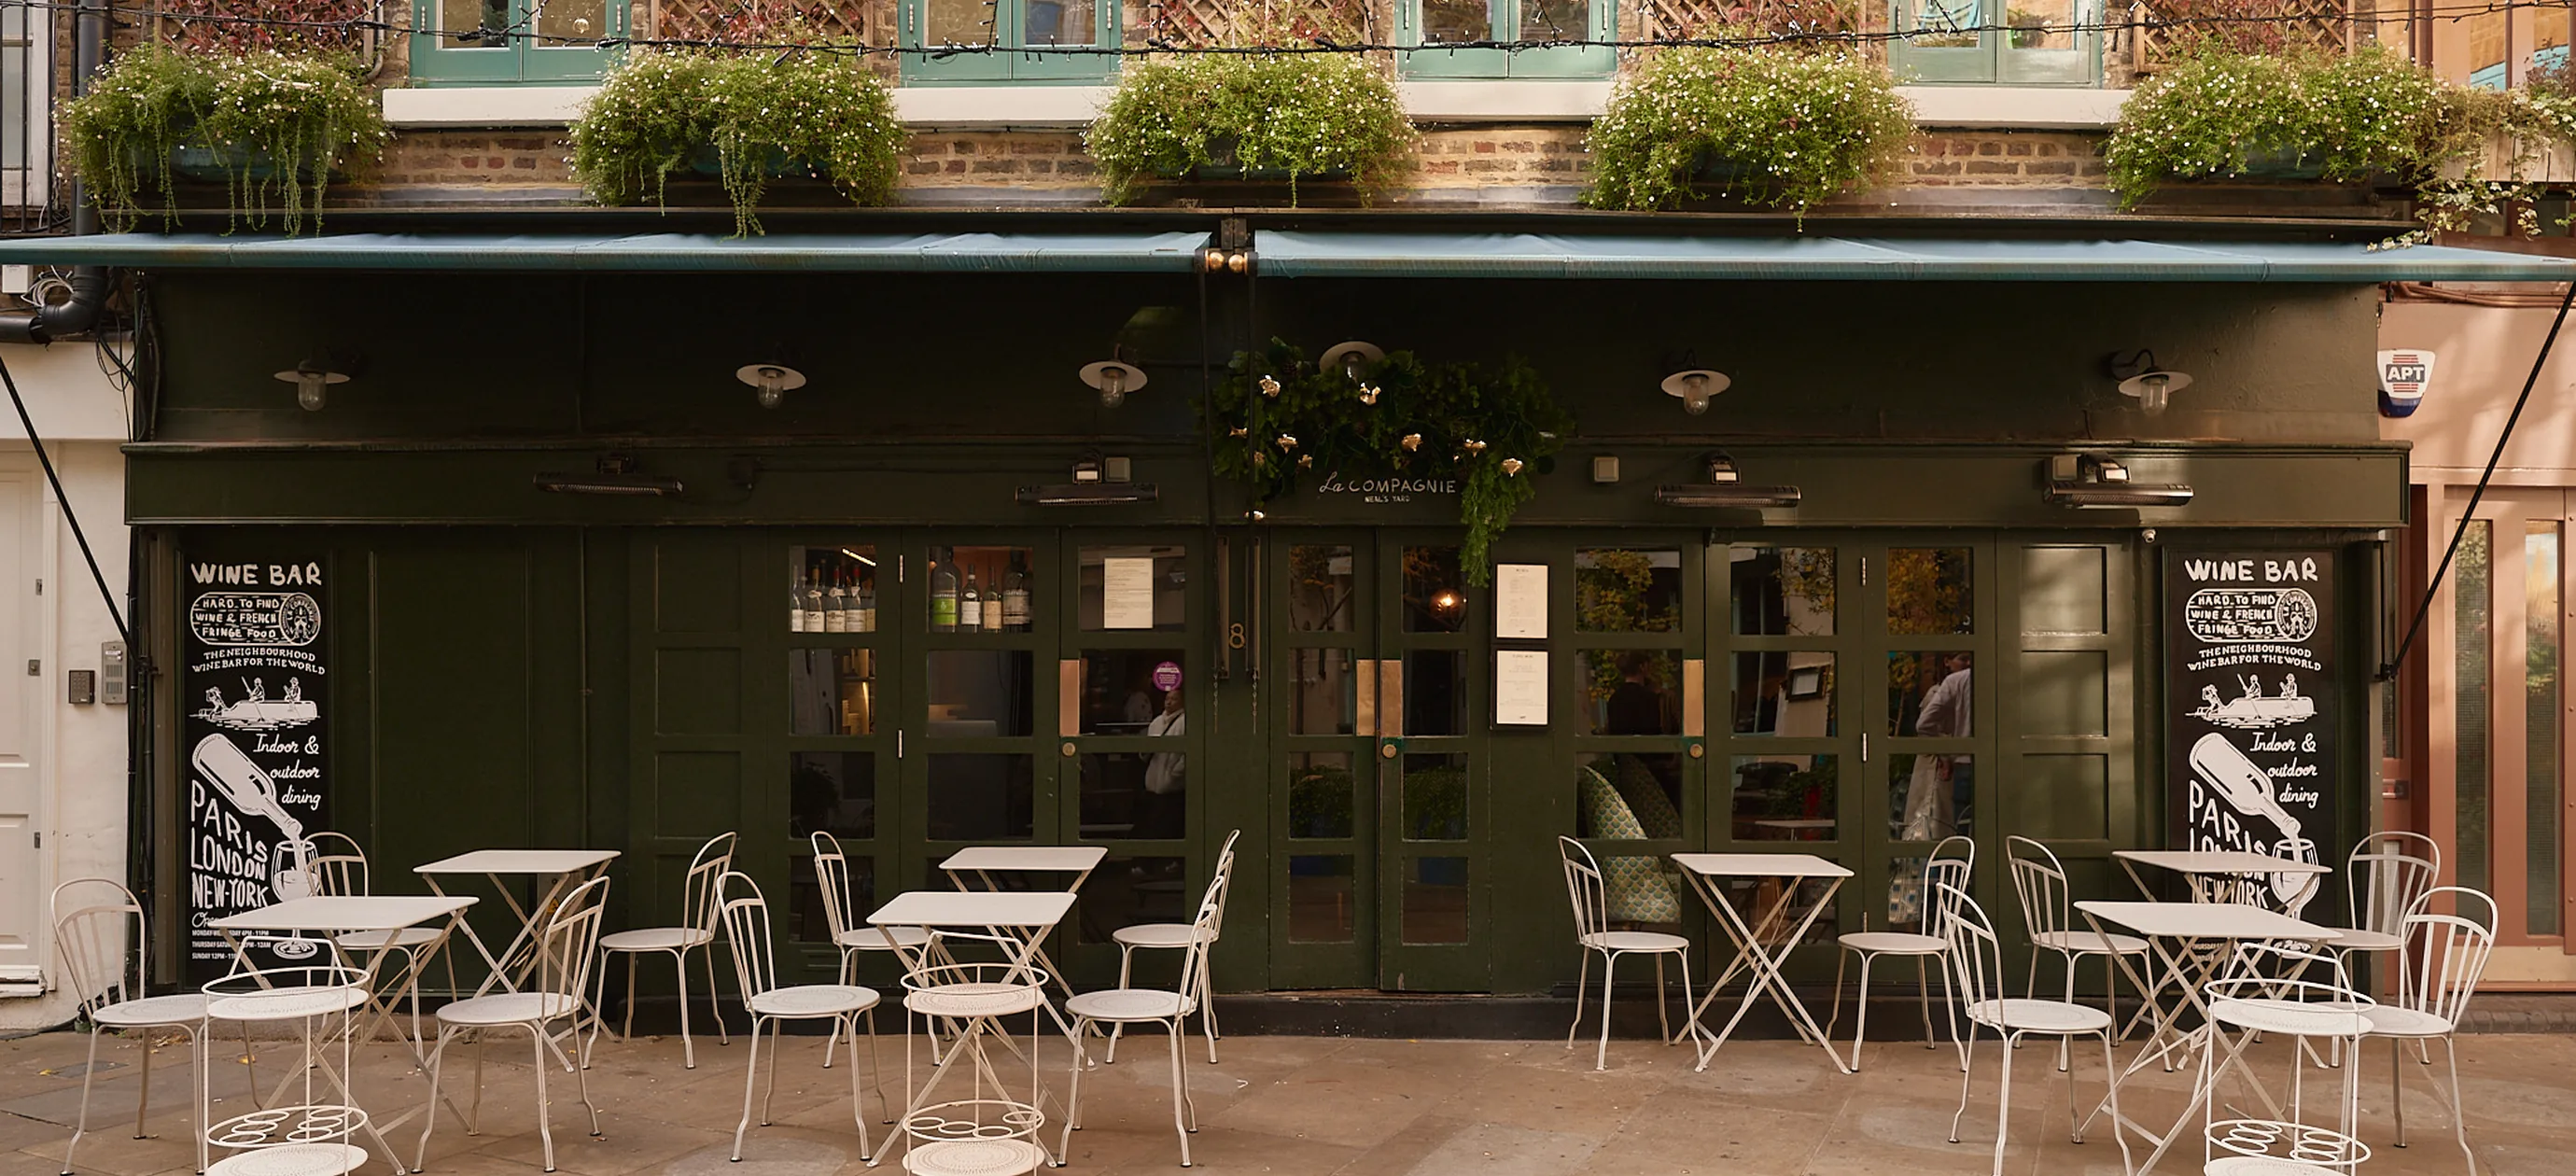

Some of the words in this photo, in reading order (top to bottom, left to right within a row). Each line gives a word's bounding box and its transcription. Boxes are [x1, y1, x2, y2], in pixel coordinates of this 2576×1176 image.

[2387, 367, 2425, 381] APT
[1319, 470, 1345, 494] La
[1348, 478, 1457, 494] COMPAGNIE
[190, 562, 259, 585] WINE
[269, 562, 322, 586] BAR
[2184, 558, 2255, 582] WINE
[2264, 557, 2318, 582] BAR
[203, 598, 234, 609] HARD
[256, 598, 280, 609] FIND
[2198, 595, 2230, 606] HARD
[2252, 595, 2275, 605] FIND
[195, 612, 223, 623] WINE
[226, 612, 236, 623] &
[239, 612, 277, 623] FRENCH
[2190, 609, 2219, 620] WINE
[2222, 609, 2233, 620] &
[2235, 609, 2274, 620] FRENCH
[202, 626, 243, 637] FRINGE
[247, 628, 276, 638] FOOD
[1229, 623, 1245, 649] 8
[2197, 623, 2238, 635] FRINGE
[2243, 624, 2273, 635] FOOD
[203, 650, 225, 660] THE
[227, 647, 315, 662] NEIGHBOURHOOD
[2198, 647, 2221, 658] THE
[2222, 644, 2312, 658] NEIGHBOURHOOD
[191, 661, 220, 672] WINE
[221, 658, 243, 668] BAR
[243, 657, 263, 666] FOR
[266, 658, 287, 667] THE
[287, 659, 326, 675] WORLD
[2187, 658, 2217, 671] WINE
[2218, 655, 2238, 666] BAR
[2238, 654, 2260, 664] FOR
[2261, 654, 2284, 665] THE
[2284, 655, 2321, 671] WORLD
[252, 733, 300, 753] Indoor
[304, 735, 320, 755] &
[2249, 732, 2296, 752] Indoor
[2301, 732, 2317, 753] &
[270, 759, 321, 779] outdoor
[2267, 757, 2317, 777] outdoor
[281, 784, 322, 811] dining
[2279, 782, 2319, 809] dining
[190, 779, 268, 863] PARIS
[2189, 779, 2267, 856] PARIS
[190, 827, 266, 882] LONDON
[191, 872, 270, 909] NEW-YORK
